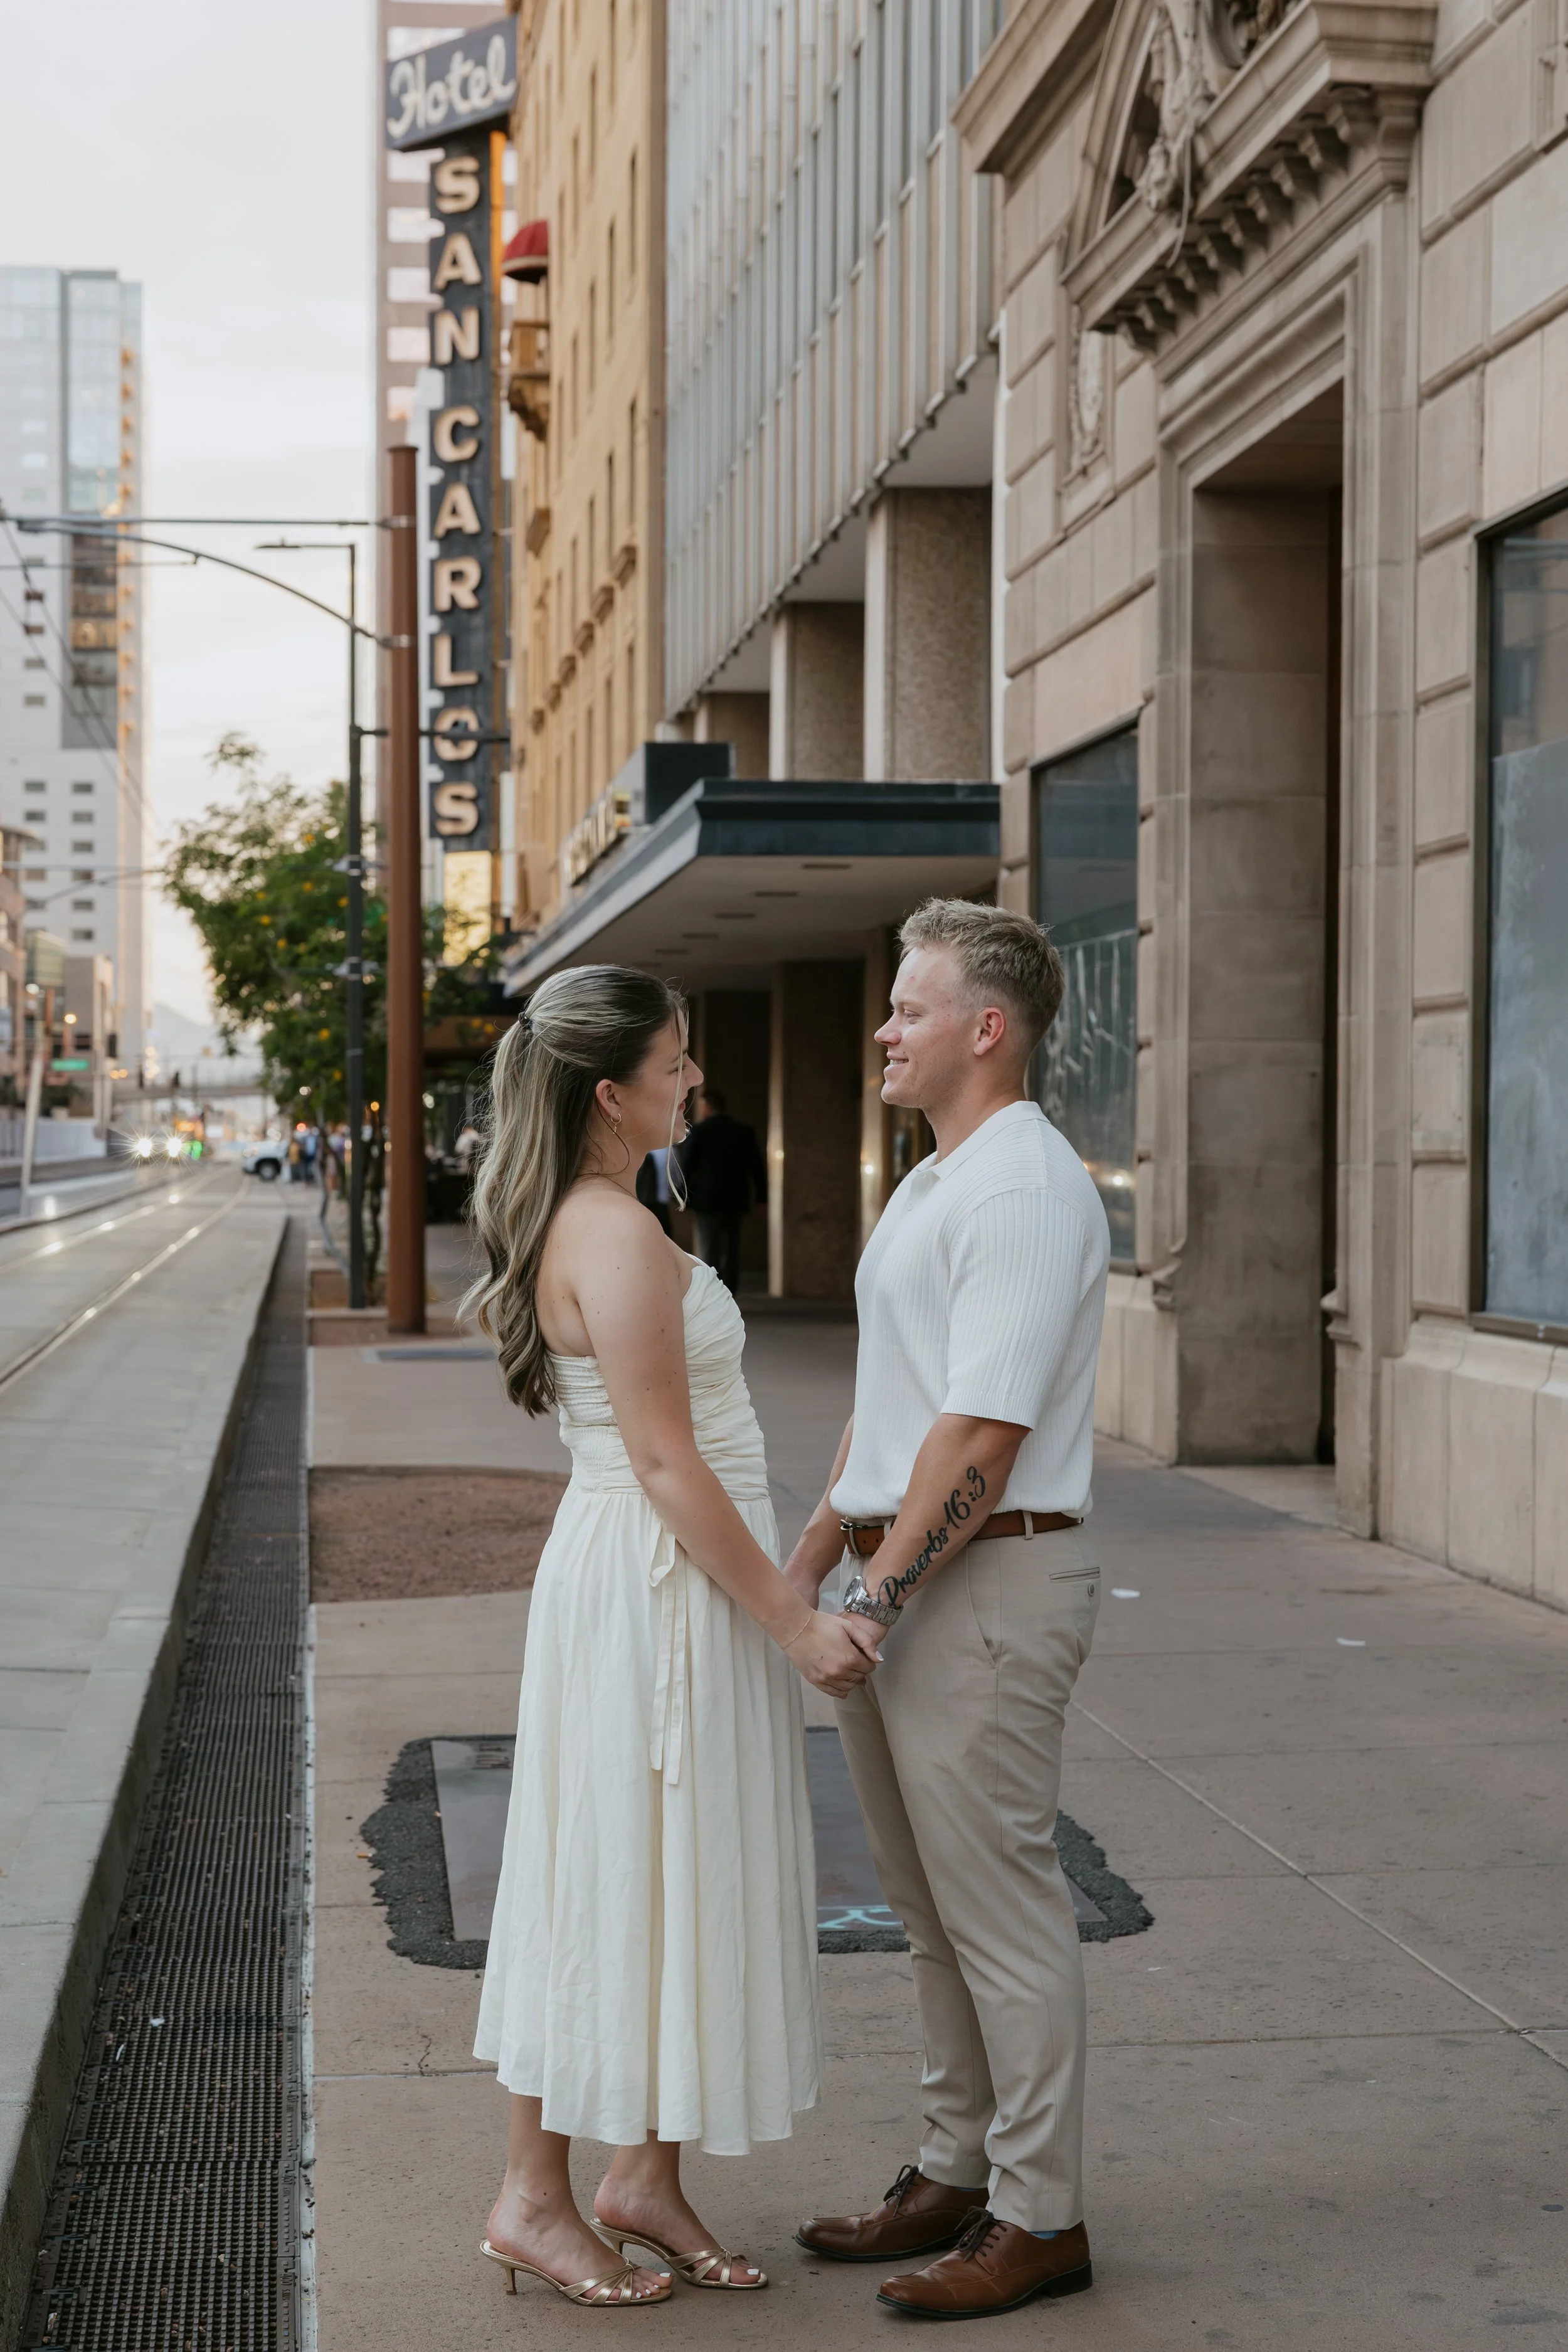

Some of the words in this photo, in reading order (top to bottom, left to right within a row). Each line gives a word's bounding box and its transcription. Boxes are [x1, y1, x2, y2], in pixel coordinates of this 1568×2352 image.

[386, 34, 517, 139] Hotel
[433, 156, 482, 366] SAN
[433, 405, 482, 835] CARLOS
[878, 1527, 948, 1606] Proverbs
[943, 1466, 985, 1529] 16:3
